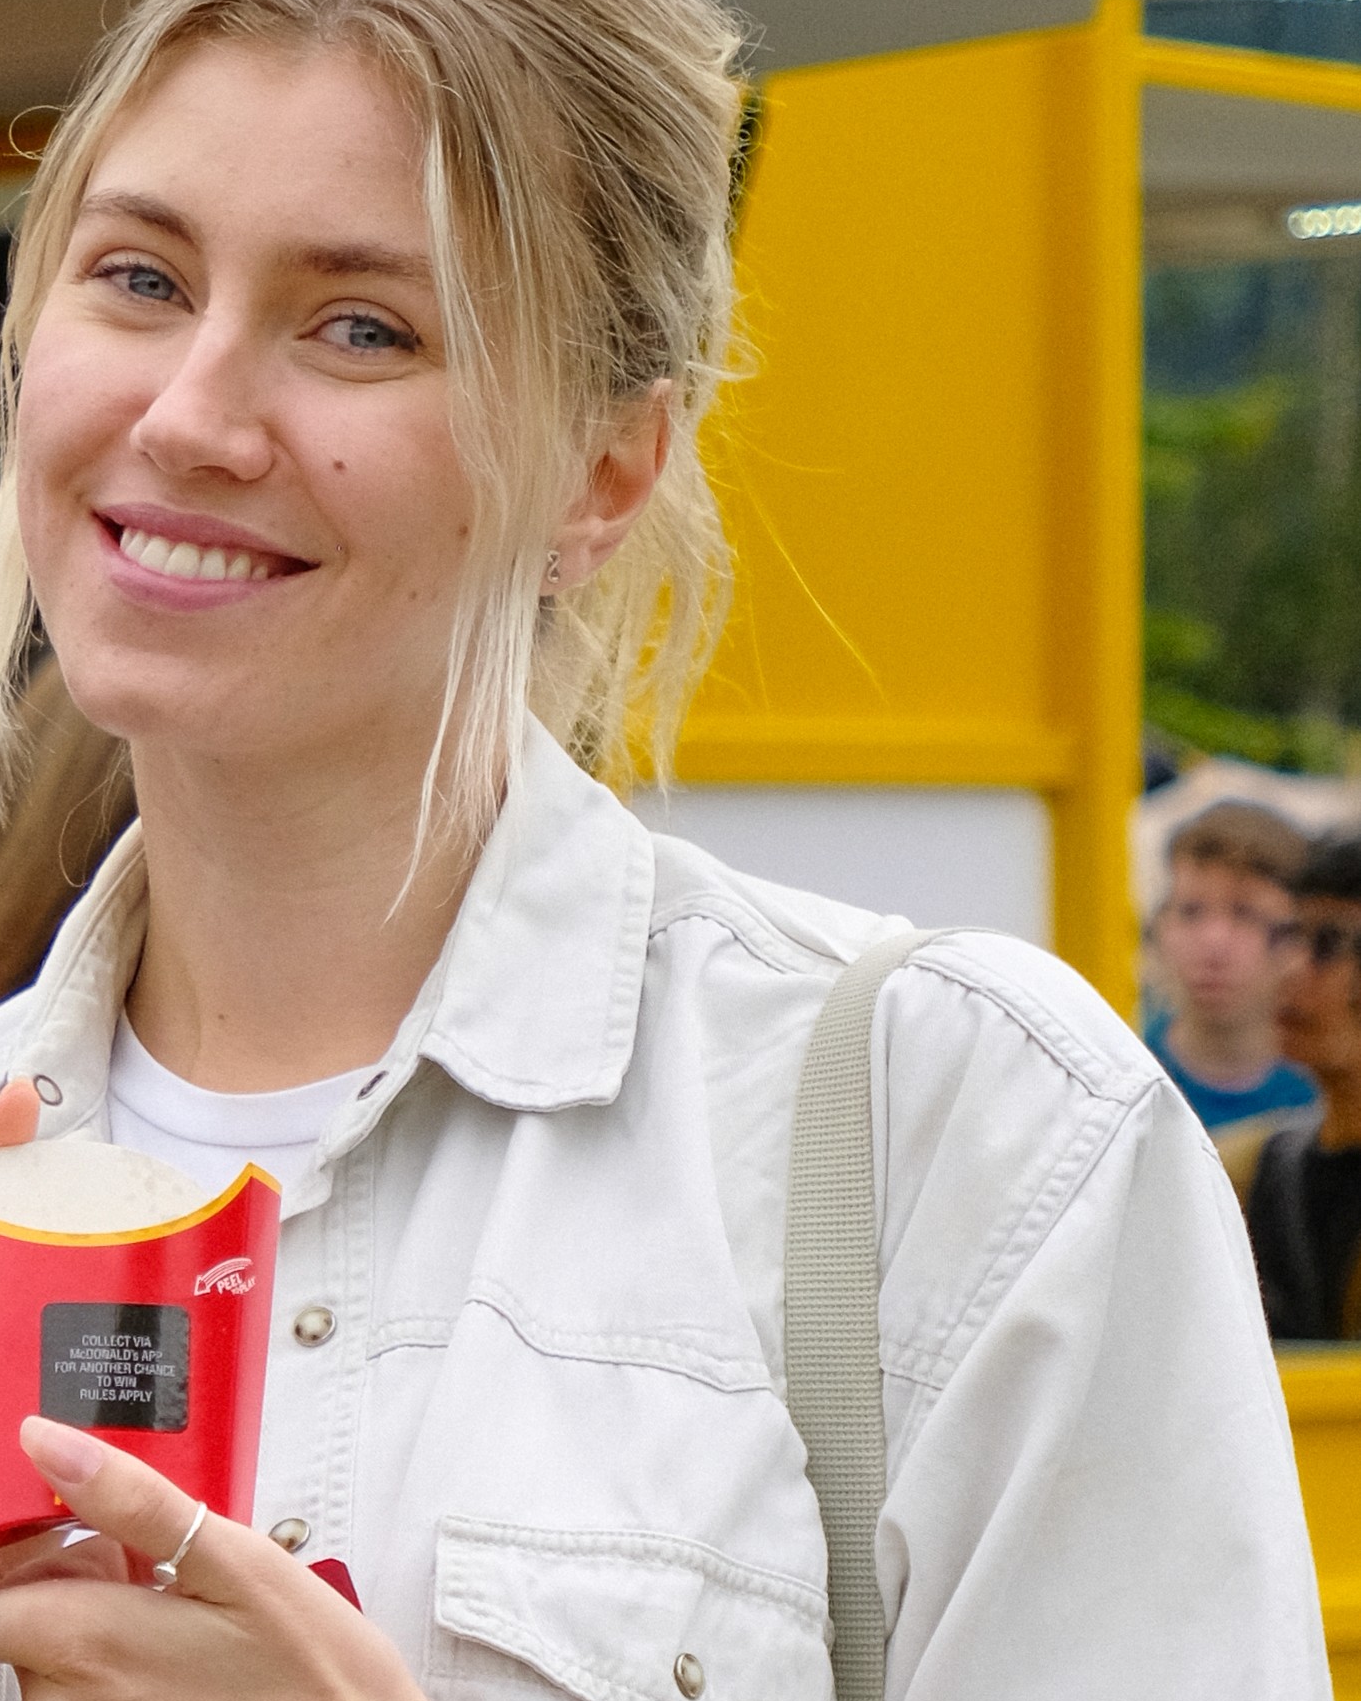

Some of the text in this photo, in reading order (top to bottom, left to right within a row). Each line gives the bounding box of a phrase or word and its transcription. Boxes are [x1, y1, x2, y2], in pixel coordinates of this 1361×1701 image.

[82, 1334, 152, 1348] COLLECT VIA
[141, 1350, 163, 1362] APP
[54, 1361, 176, 1377] FOR ANOTHER CHANCE
[96, 1375, 137, 1388] TO WIN
[80, 1388, 153, 1402] RULES APPLY
